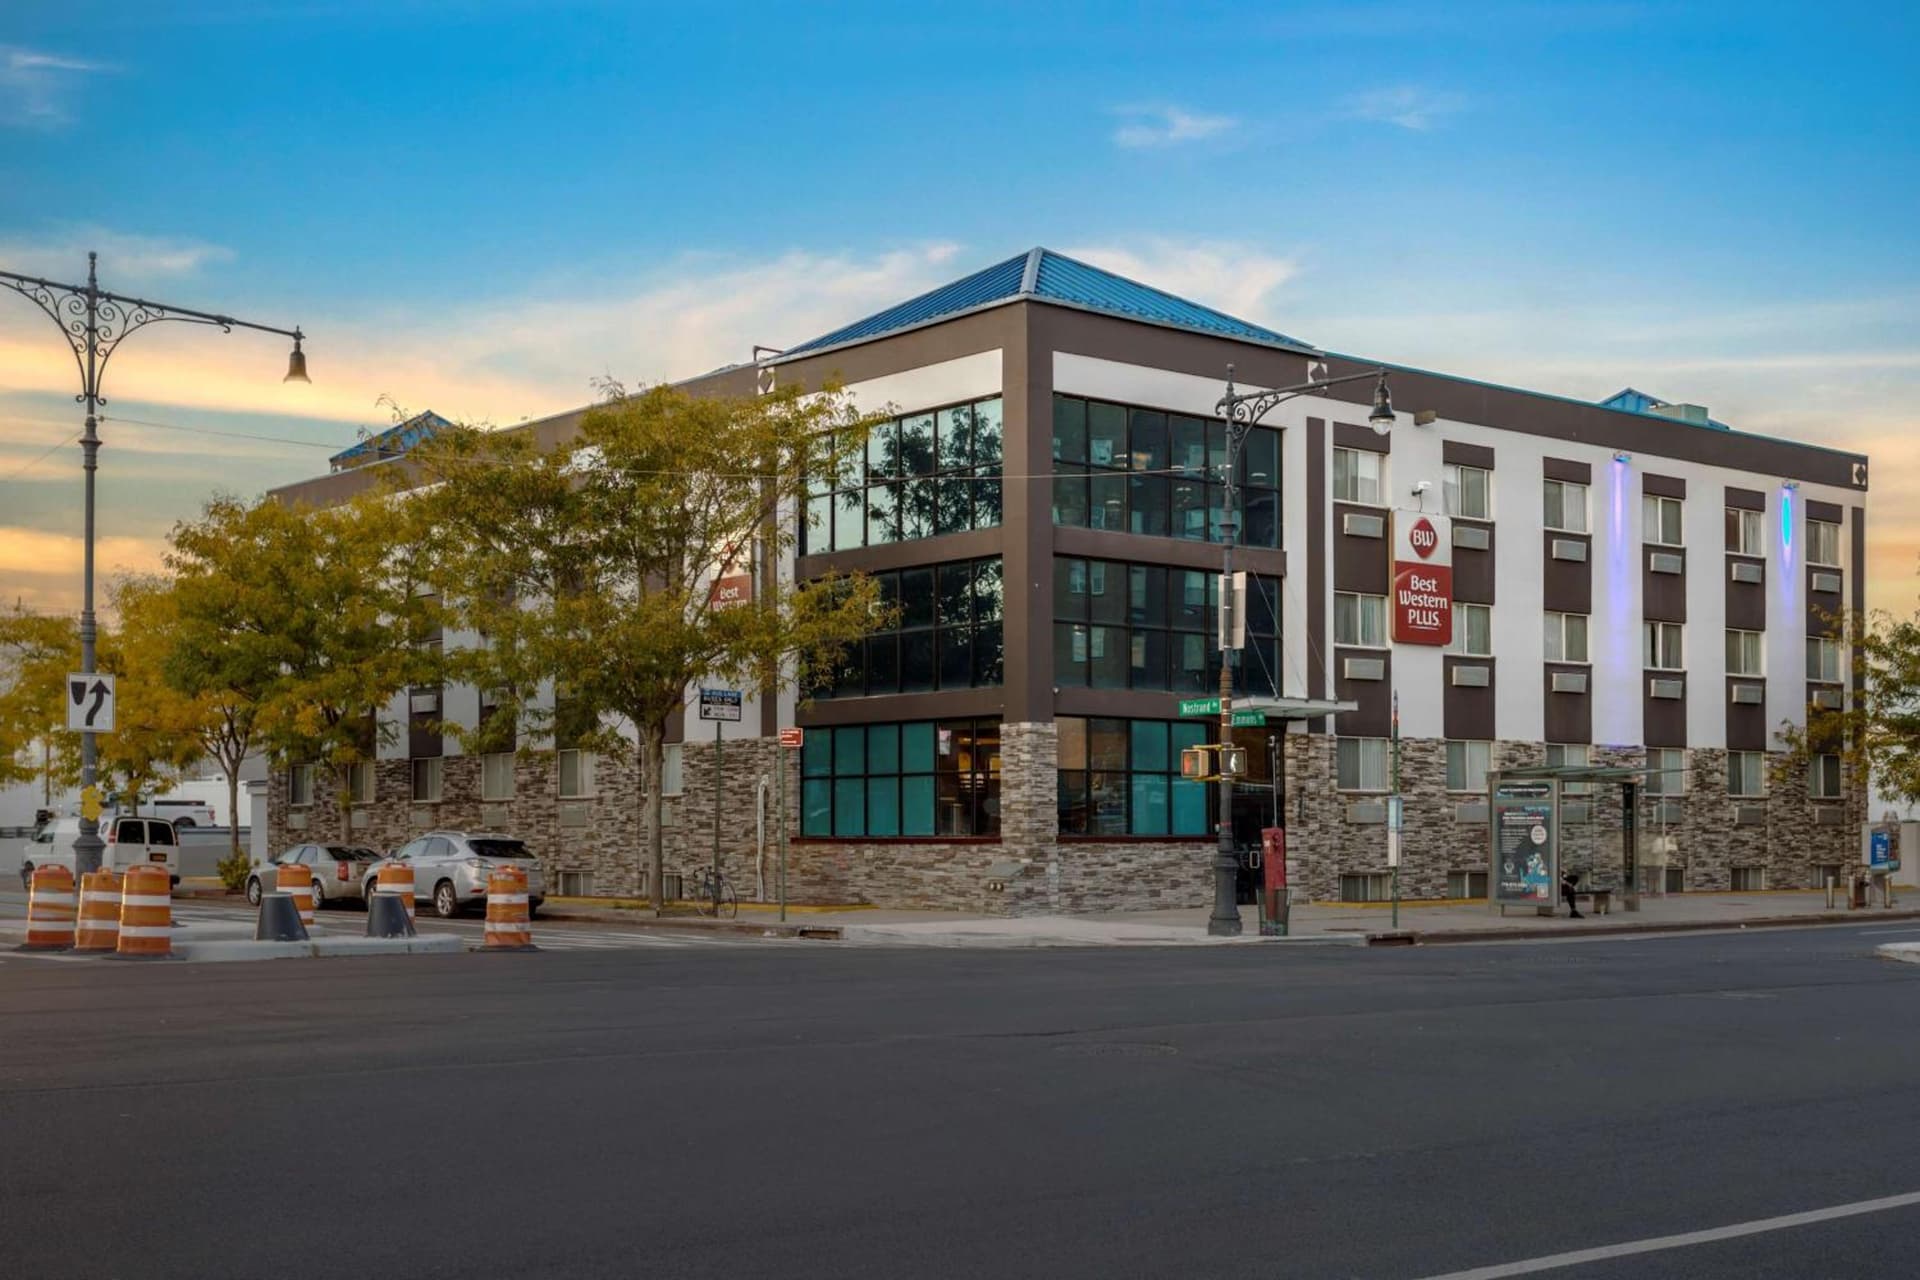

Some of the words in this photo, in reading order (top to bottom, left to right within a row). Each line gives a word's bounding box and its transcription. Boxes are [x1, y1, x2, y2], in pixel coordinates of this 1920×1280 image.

[1413, 529, 1434, 546] BW
[1410, 575, 1437, 592] Best
[1399, 589, 1448, 609] Western
[1408, 608, 1440, 626] PLUS
[1183, 702, 1210, 713] Nostrand
